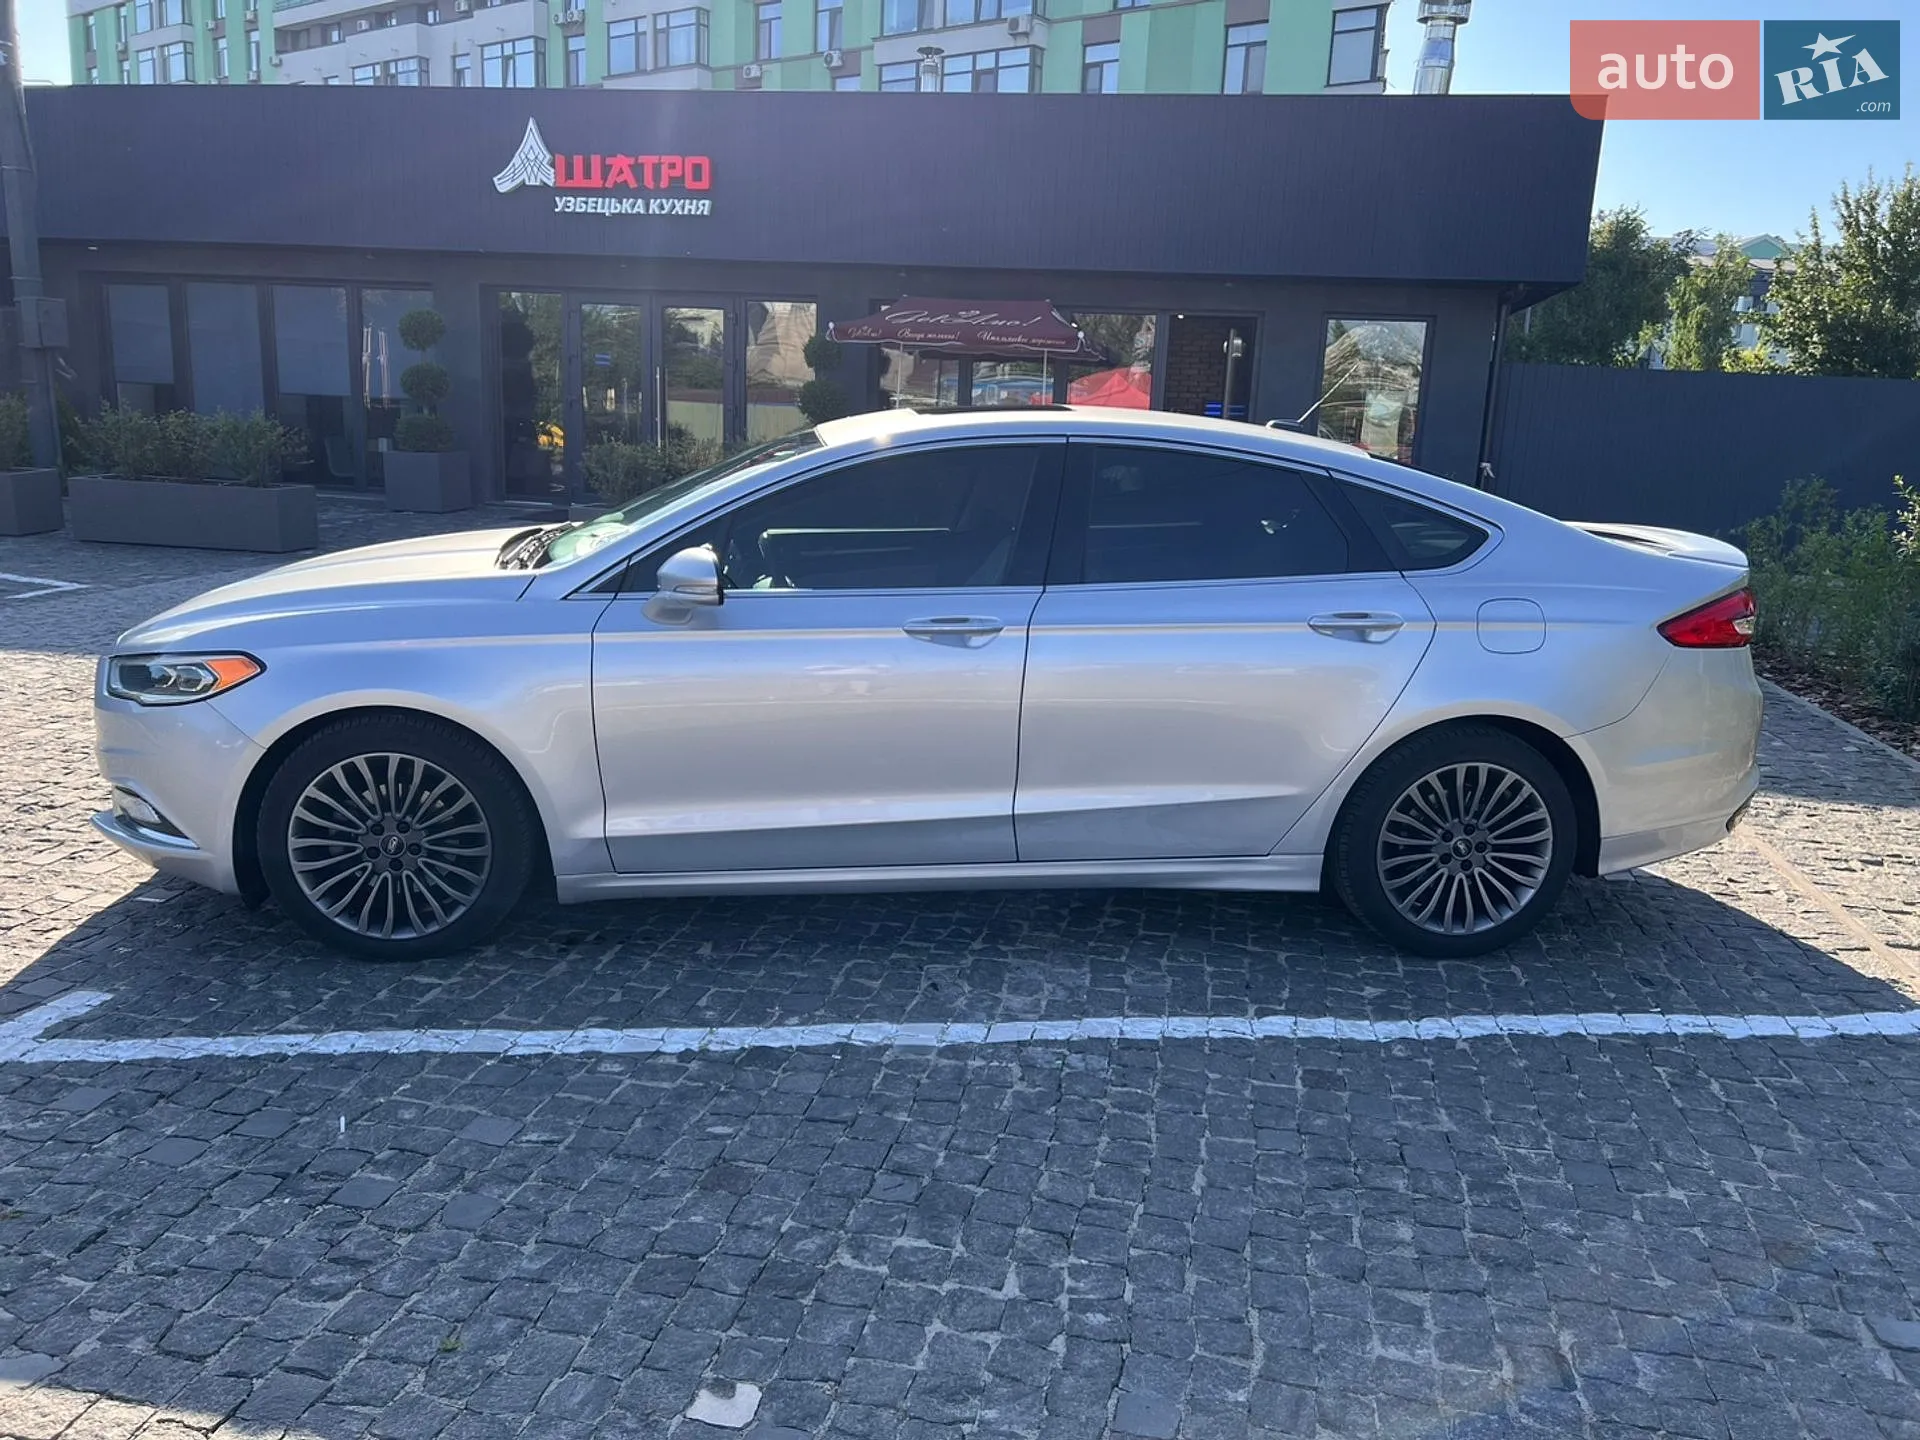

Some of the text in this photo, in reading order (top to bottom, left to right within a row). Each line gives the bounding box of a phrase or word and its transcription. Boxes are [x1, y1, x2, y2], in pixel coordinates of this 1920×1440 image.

[554, 153, 712, 190] ШАТРО
[554, 196, 712, 216] УЗБЕЦЬКА КУХНЯ
